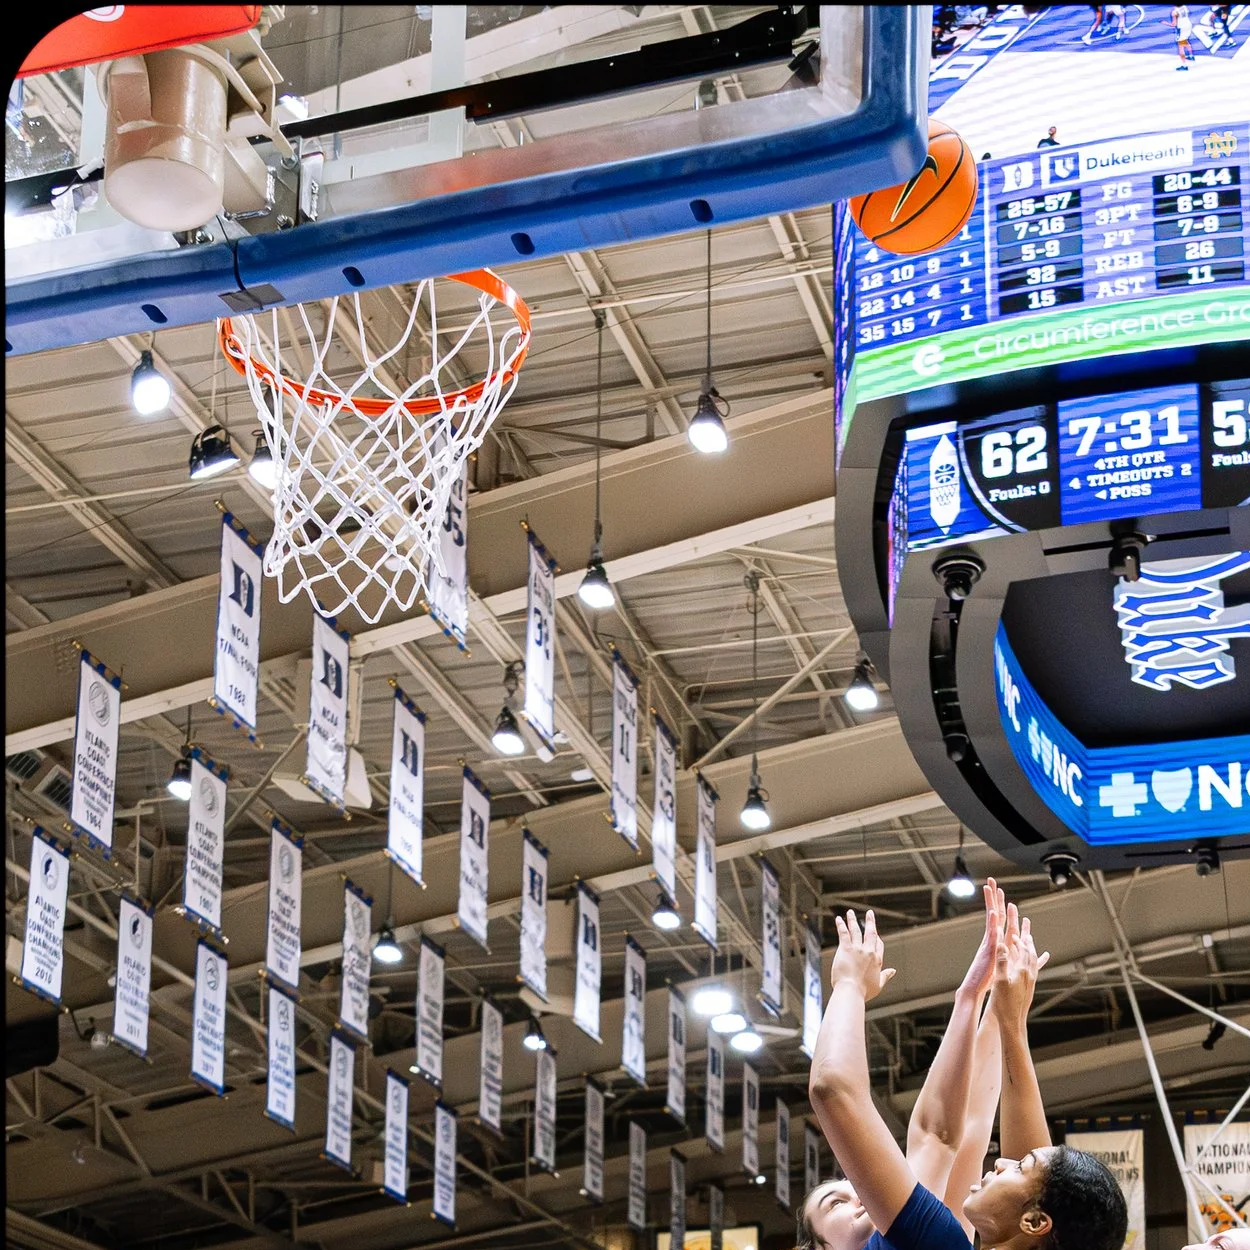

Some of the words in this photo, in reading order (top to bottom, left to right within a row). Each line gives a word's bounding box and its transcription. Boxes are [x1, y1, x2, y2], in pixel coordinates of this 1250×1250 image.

[1086, 146, 1185, 170] DukeHealth
[1102, 182, 1131, 201] FG
[1164, 168, 1231, 192] 20-44
[1008, 192, 1071, 218] 25-57
[1095, 204, 1142, 225] 3PT
[1177, 192, 1218, 213] 6-9
[1014, 217, 1065, 240] 7-16
[1102, 229, 1135, 248] FT
[1177, 215, 1219, 236] 7-9
[860, 273, 884, 291] 12
[890, 265, 914, 283] 10
[927, 258, 940, 274] 9
[960, 251, 972, 267] 1
[865, 248, 879, 262] 4
[1021, 240, 1059, 261] 5-9
[1095, 252, 1143, 273] REB
[1185, 241, 1215, 260] 26
[860, 299, 884, 317] 22
[891, 291, 915, 309] 14
[927, 284, 940, 299] 4
[960, 278, 973, 294] 1
[1026, 265, 1056, 285] 32
[1096, 276, 1146, 298] AST
[1188, 265, 1215, 284] 11
[1028, 289, 1056, 309] 15
[860, 325, 884, 343] 35
[891, 317, 914, 336] 15
[928, 311, 941, 326] 7
[960, 305, 973, 320] 1
[973, 307, 1195, 359] Circumference
[1069, 407, 1188, 457] 7:31
[981, 426, 1047, 478] 62
[1094, 455, 1129, 470] 4TH
[1131, 451, 1166, 467] QTR
[989, 485, 1037, 502] Fouls:
[1069, 477, 1081, 490] 4
[1086, 466, 1174, 487] TIMEOUTS
[1181, 464, 1192, 477] 2
[1110, 484, 1151, 500] POSS
